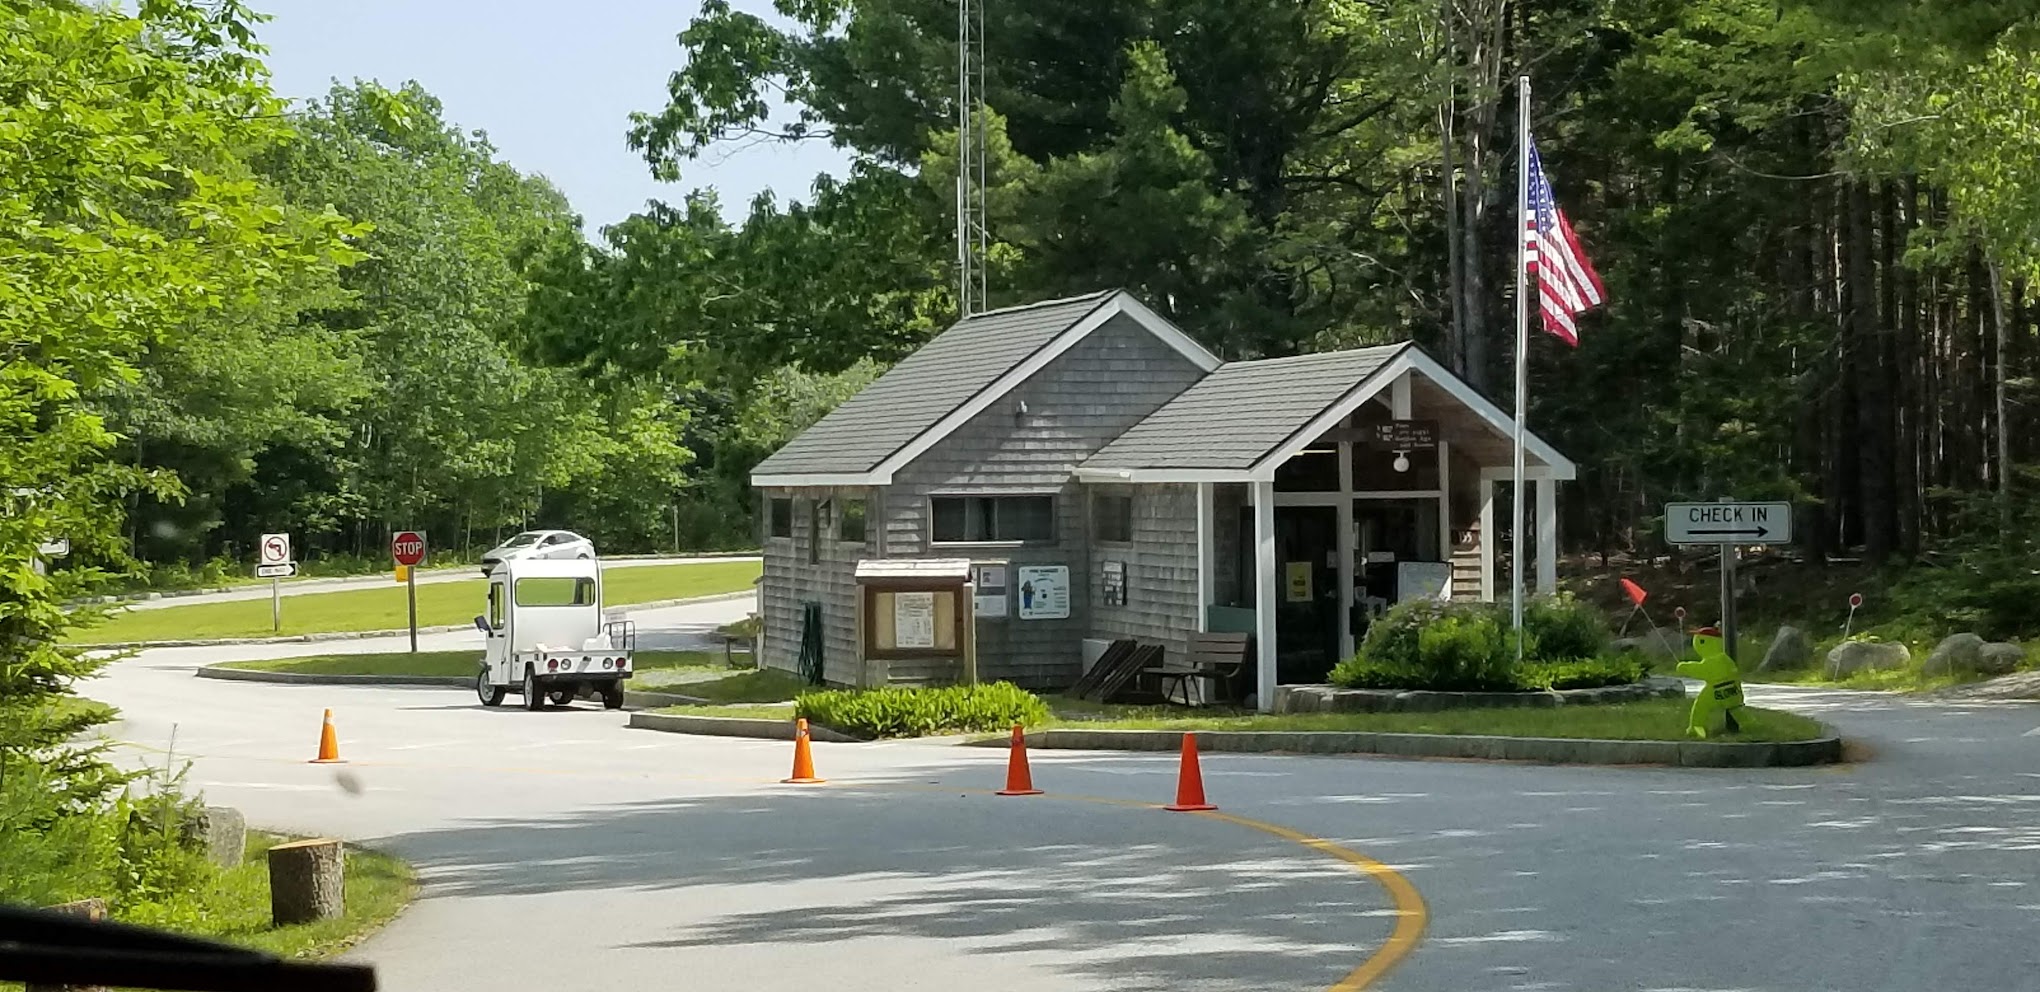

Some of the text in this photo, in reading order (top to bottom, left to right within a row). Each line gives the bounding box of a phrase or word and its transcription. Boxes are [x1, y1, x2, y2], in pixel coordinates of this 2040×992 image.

[1689, 507, 1767, 522] CHECK IN
[395, 541, 423, 556] STOP
